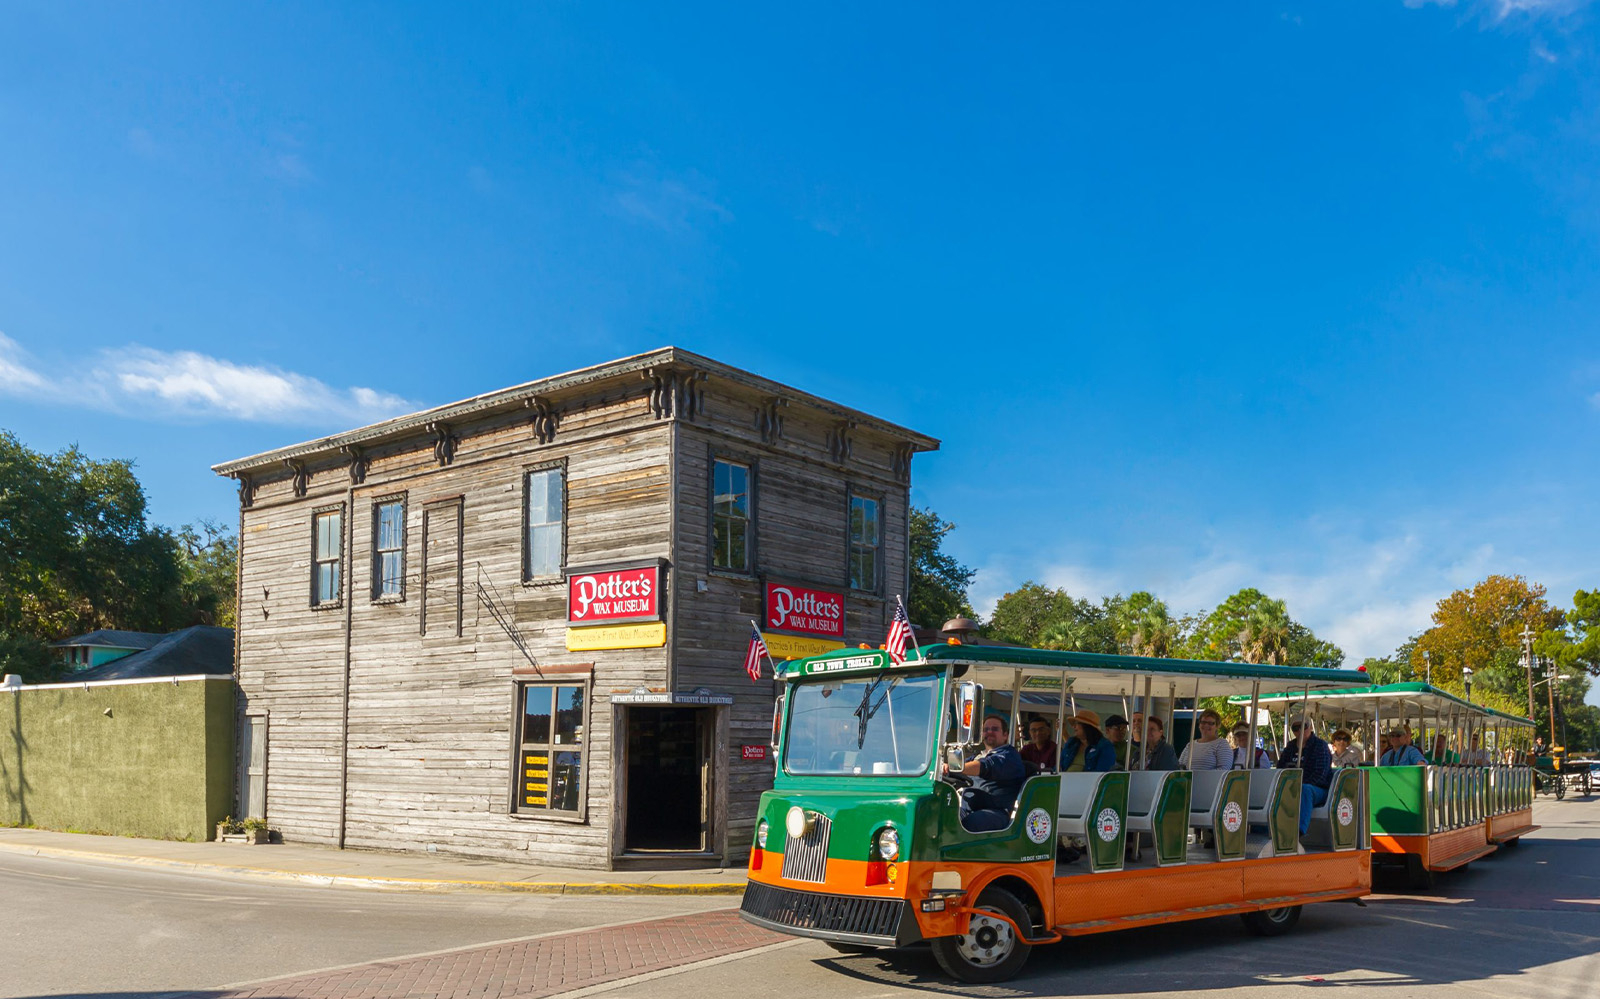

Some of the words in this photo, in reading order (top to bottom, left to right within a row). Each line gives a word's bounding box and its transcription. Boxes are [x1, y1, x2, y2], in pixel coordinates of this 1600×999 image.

[573, 573, 652, 619] Potter's
[593, 602, 611, 615] WAX
[613, 599, 649, 613] MUSEUM
[771, 587, 840, 627] Potter's
[789, 615, 806, 628] WAX
[809, 618, 838, 632] MUSEUM
[794, 642, 807, 652] First
[808, 643, 821, 655] Wax
[813, 662, 825, 672] OLD
[826, 660, 844, 671] TOWN
[846, 657, 875, 669] TROLLEY
[929, 771, 935, 780] 7
